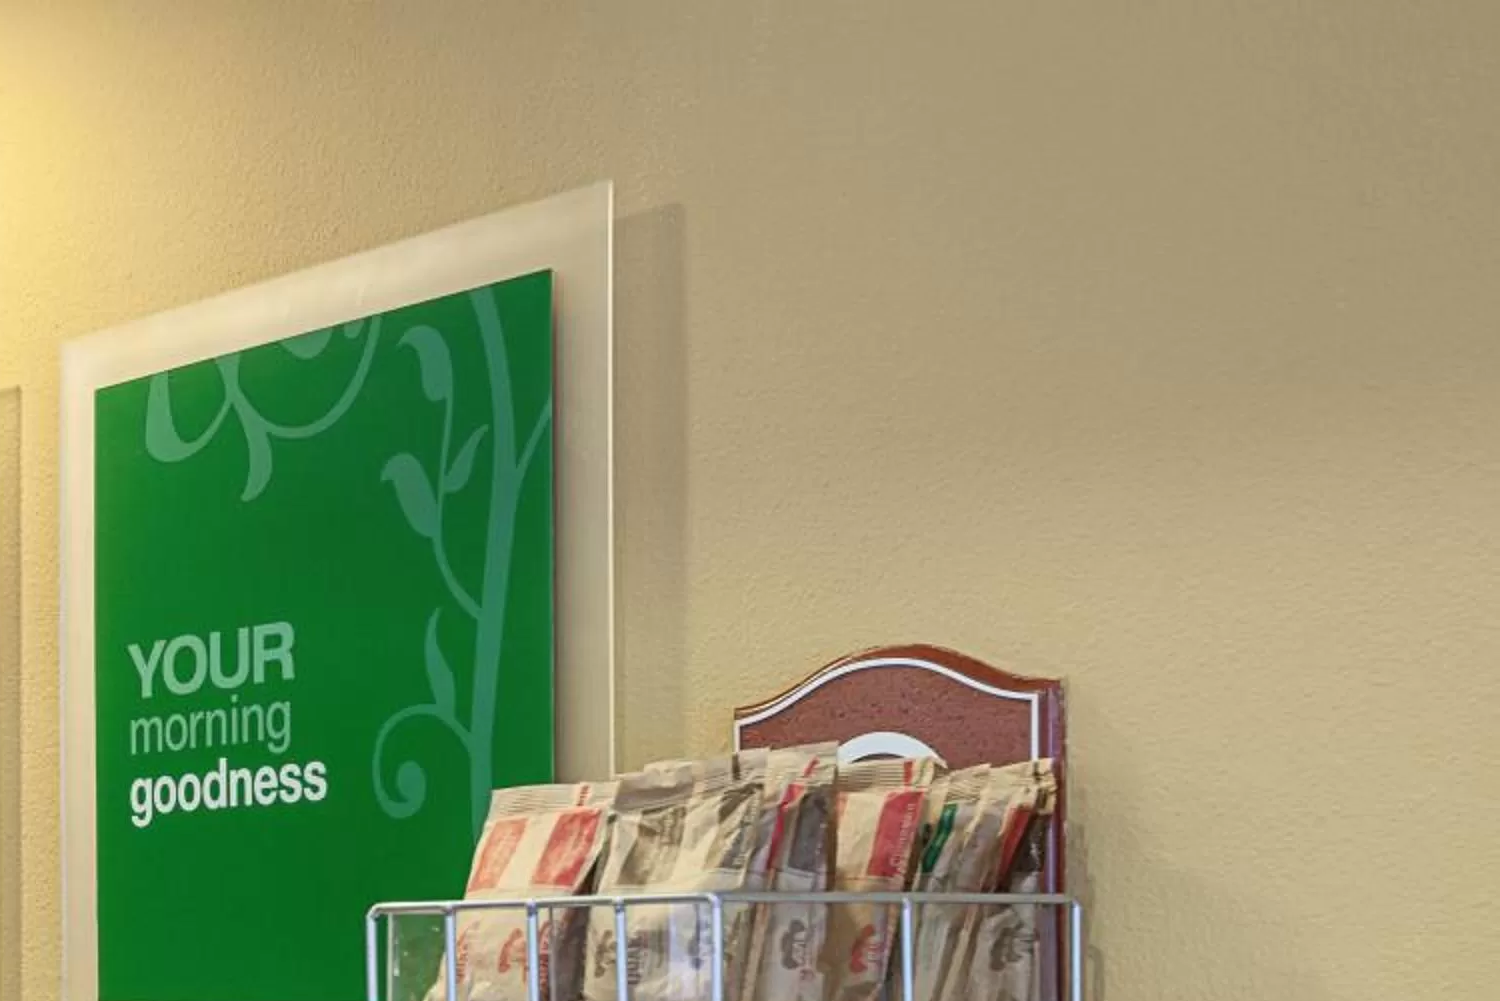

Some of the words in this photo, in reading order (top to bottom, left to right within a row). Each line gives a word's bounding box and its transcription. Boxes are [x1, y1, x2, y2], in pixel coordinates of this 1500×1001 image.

[127, 621, 296, 700] YOUR
[130, 695, 292, 754] morning
[129, 757, 328, 828] goodness
